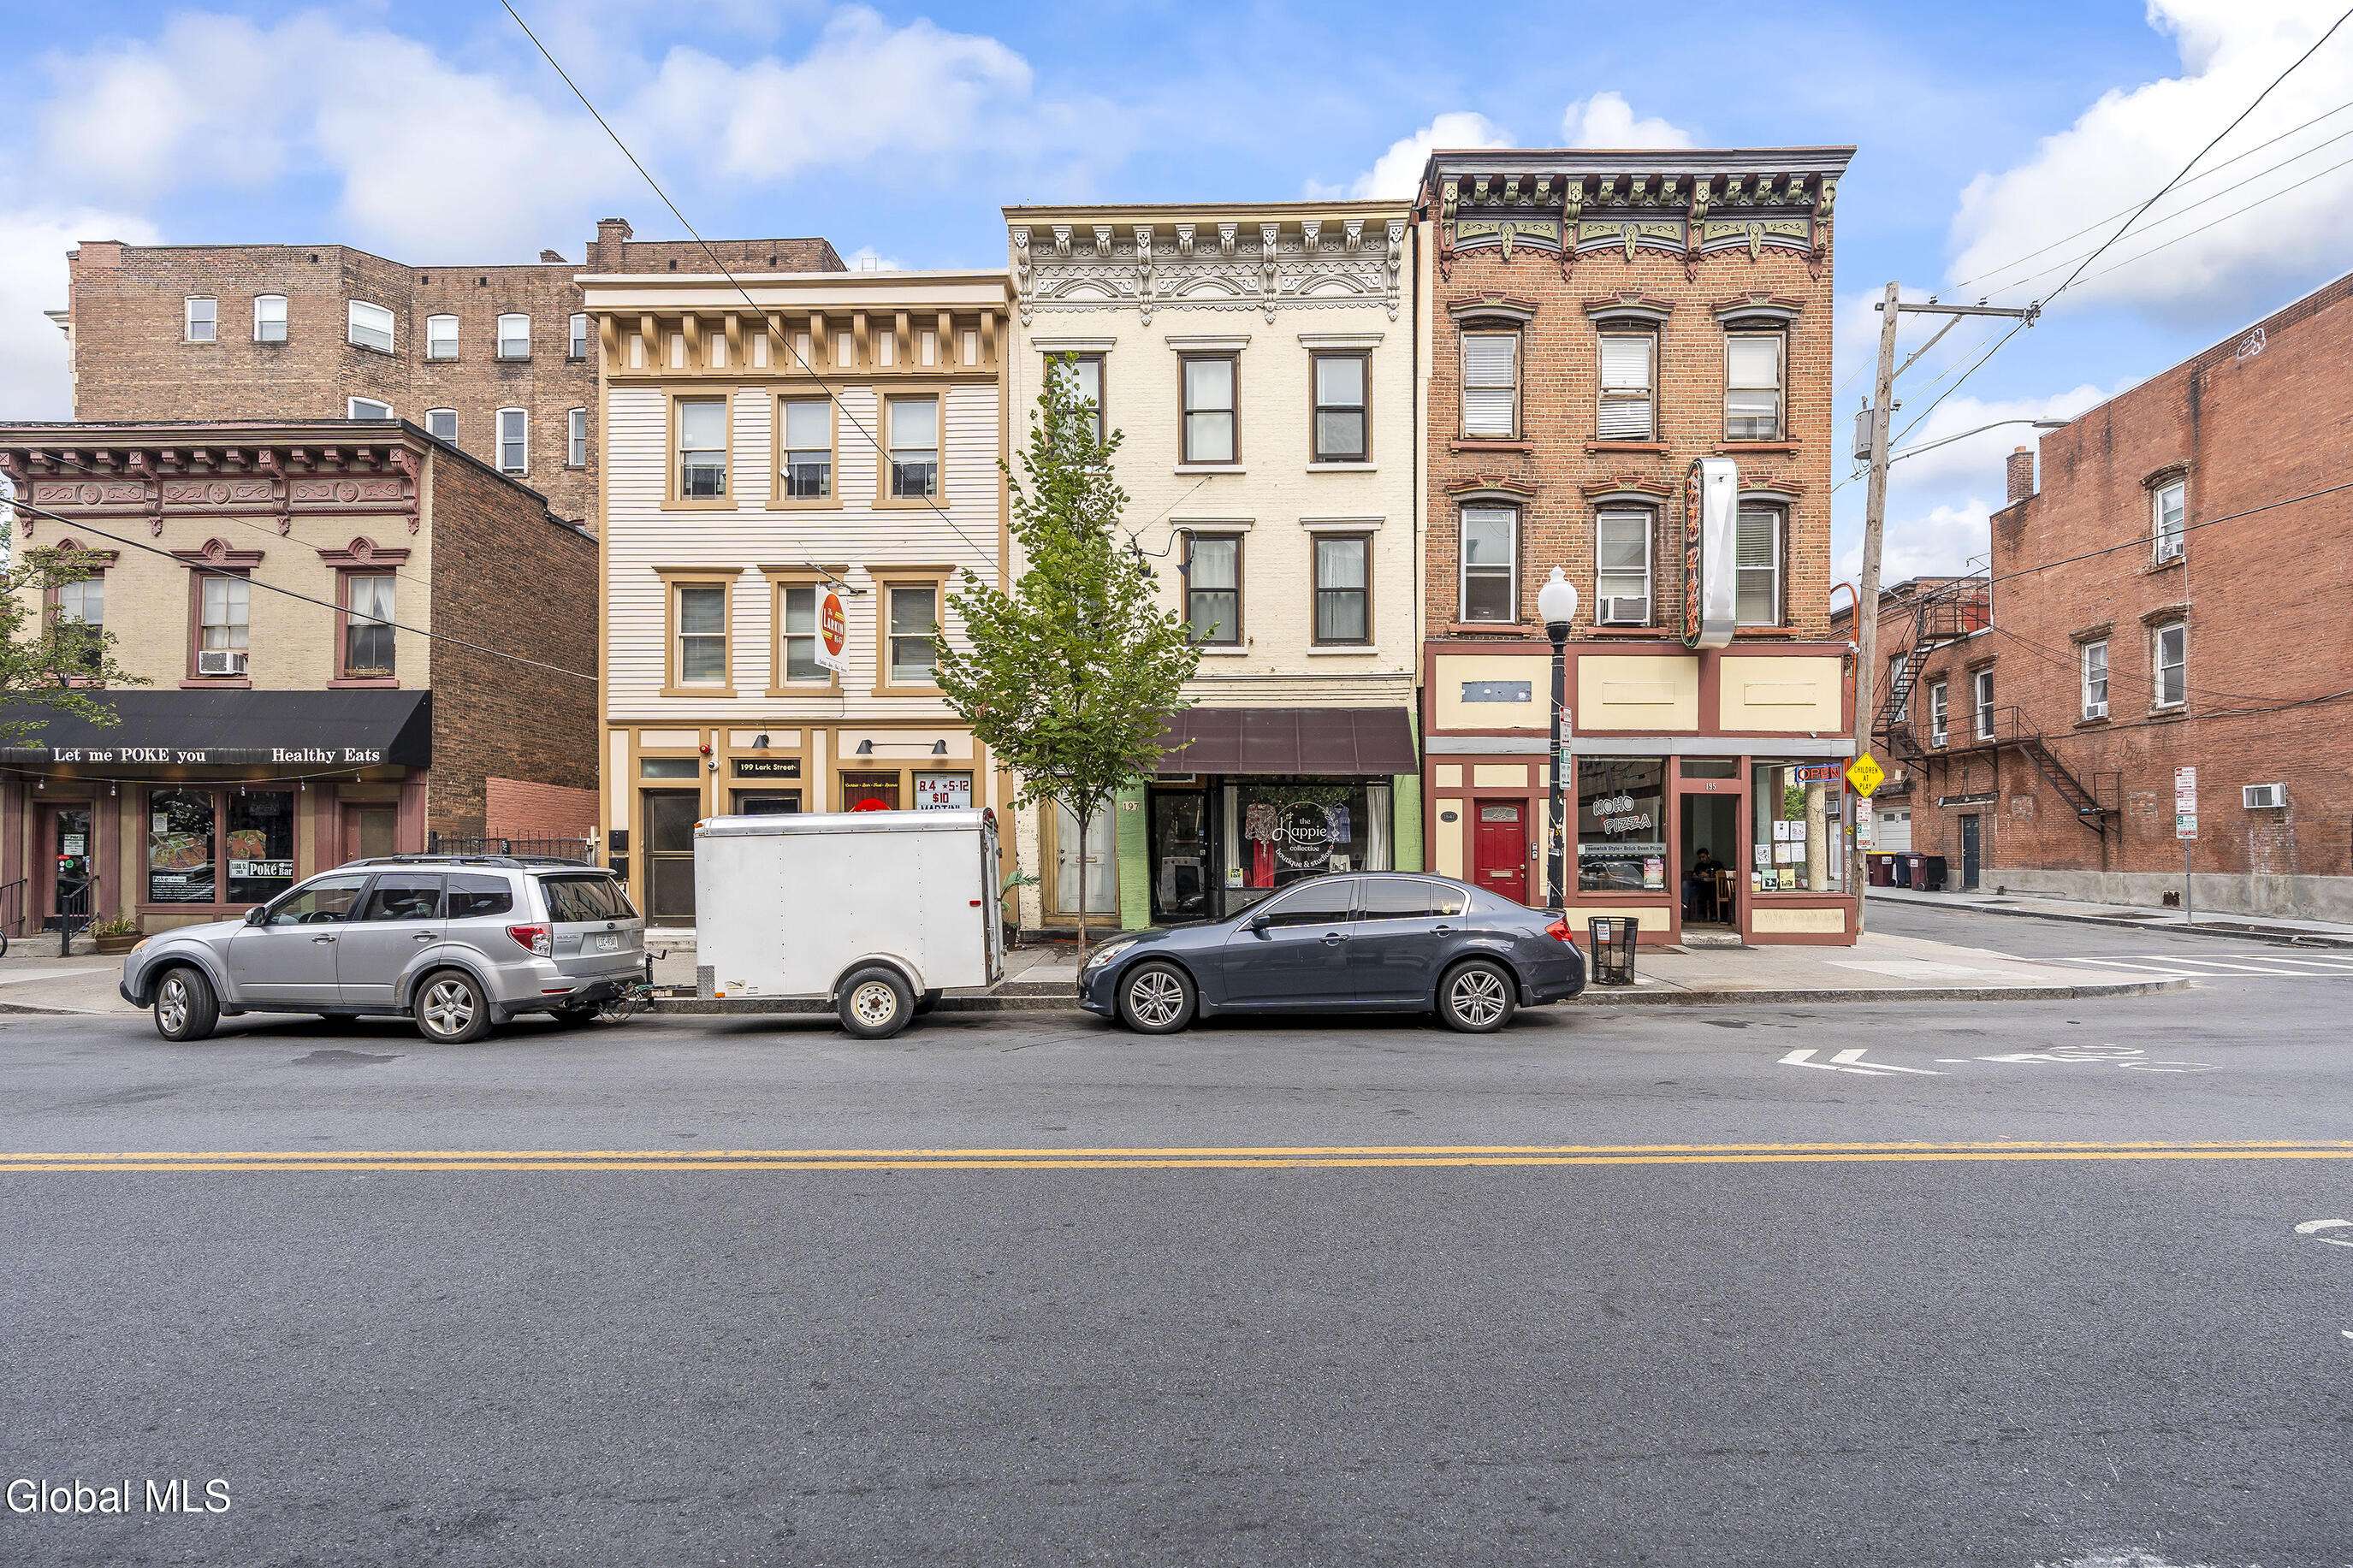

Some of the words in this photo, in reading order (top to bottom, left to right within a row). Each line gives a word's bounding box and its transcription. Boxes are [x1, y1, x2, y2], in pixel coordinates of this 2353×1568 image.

[822, 607, 844, 636] LARKIN
[53, 747, 81, 761] Let
[88, 750, 113, 761] me
[120, 747, 169, 761] POKE
[176, 750, 206, 764] you
[271, 747, 336, 764] Healthy
[343, 747, 380, 762] Eats
[1798, 767, 1840, 781] OPEN
[1853, 766, 1878, 774] CHILDREN
[1706, 782, 1716, 790] 195
[1858, 782, 1872, 790] PLAY
[933, 792, 949, 803] $10
[1123, 802, 1140, 811] 197
[1592, 796, 1634, 816] NOHO
[1272, 816, 1327, 845] Happie
[1603, 814, 1651, 835] PIZZA
[1275, 848, 1302, 867] boutique
[1310, 849, 1332, 867] studios
[249, 863, 277, 876] Poké
[279, 867, 293, 876] Bar
